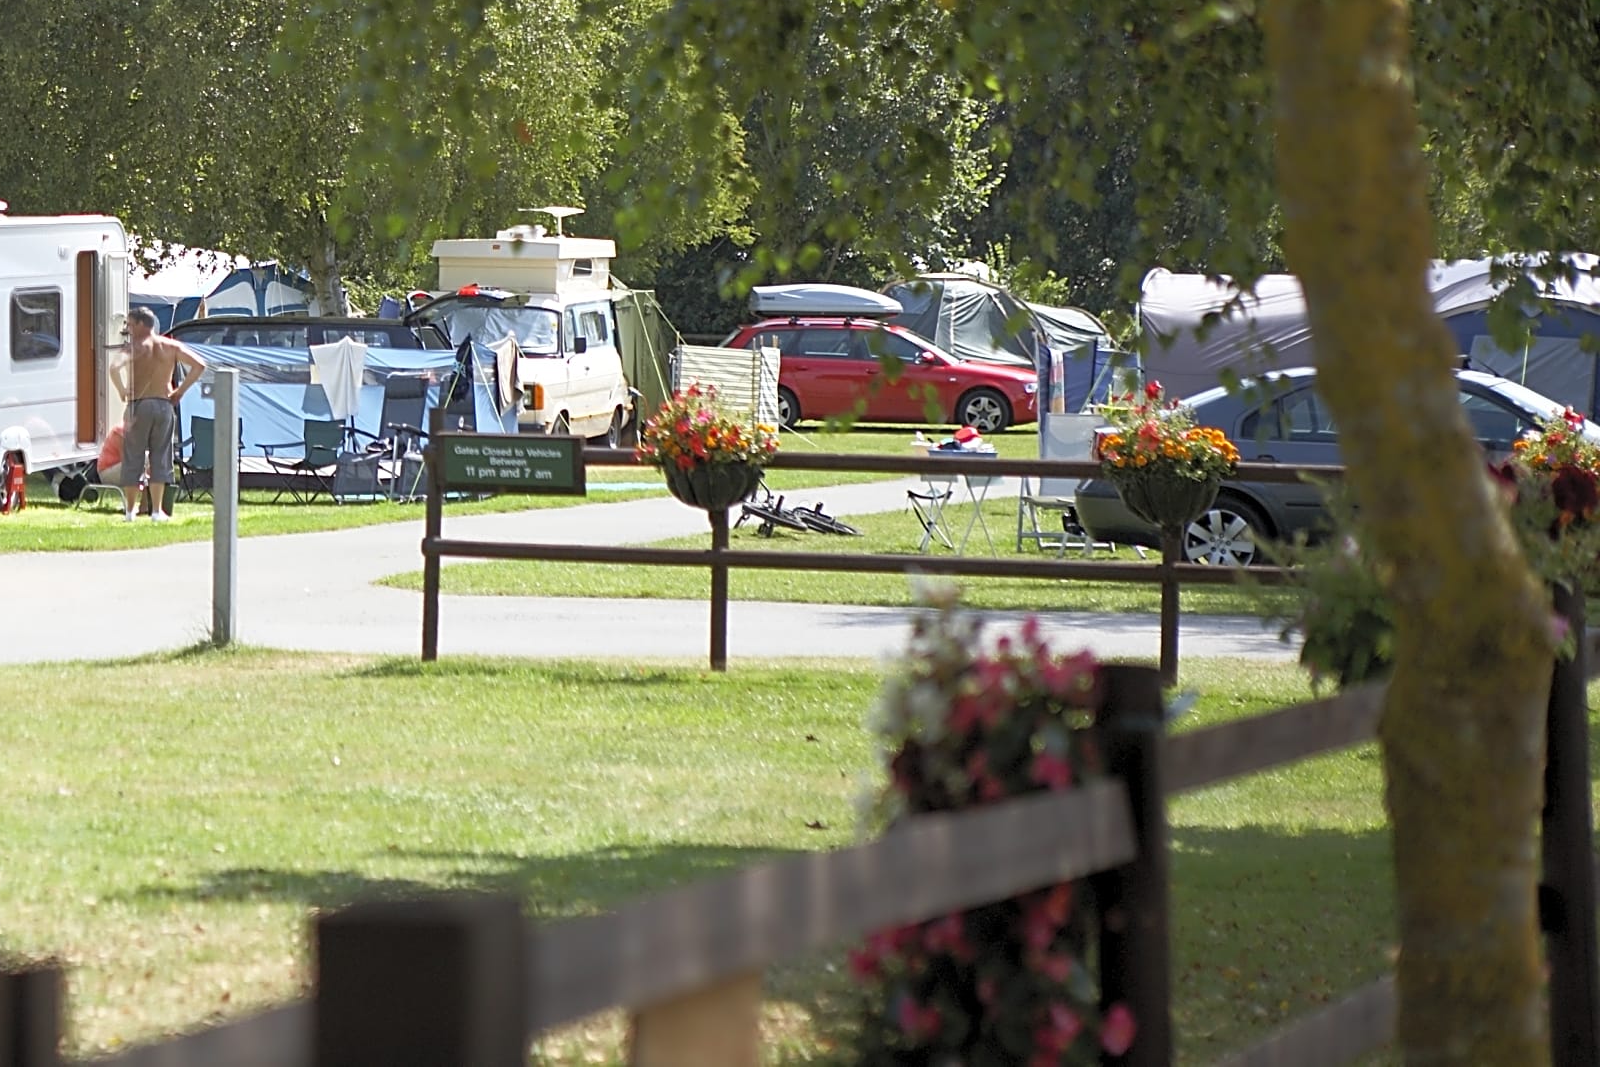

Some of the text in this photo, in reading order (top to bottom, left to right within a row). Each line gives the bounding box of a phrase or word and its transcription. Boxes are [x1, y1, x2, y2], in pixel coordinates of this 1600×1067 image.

[454, 446, 561, 458] Gates Closed to Vehicles
[490, 457, 527, 466] Between
[466, 466, 552, 479] 11 pm and 7 am
